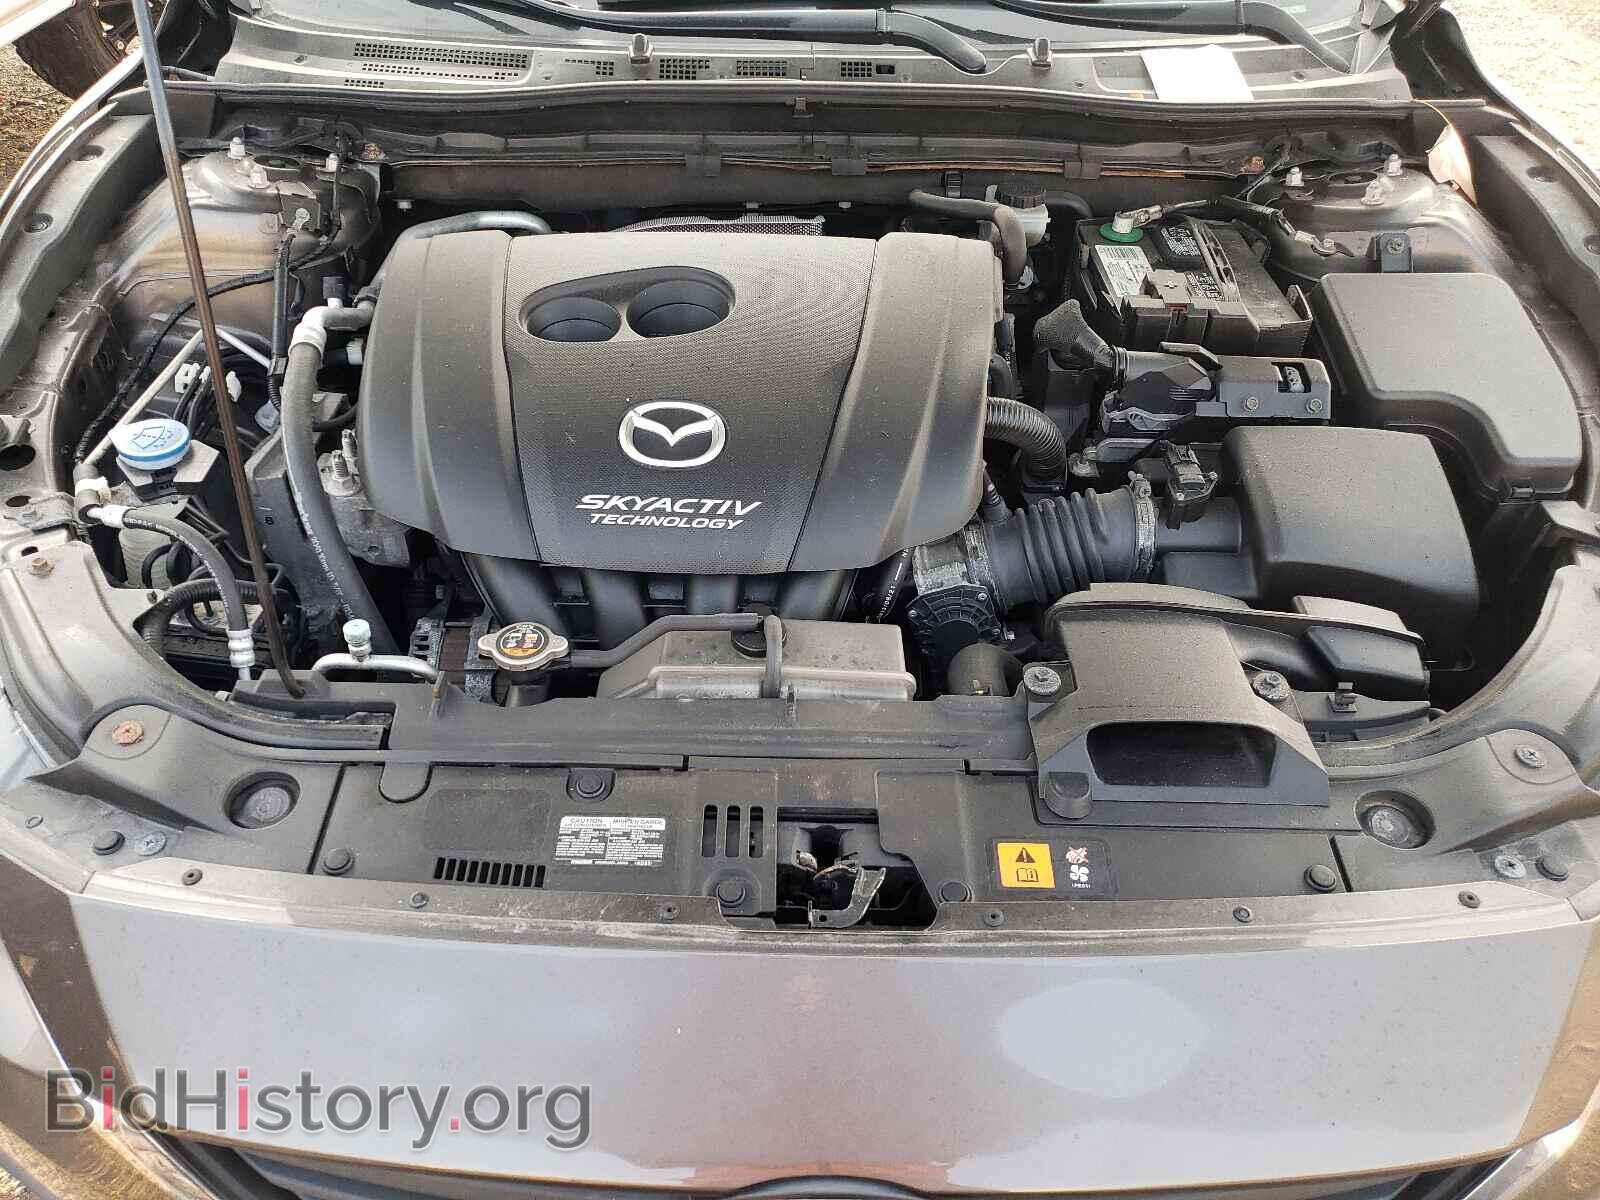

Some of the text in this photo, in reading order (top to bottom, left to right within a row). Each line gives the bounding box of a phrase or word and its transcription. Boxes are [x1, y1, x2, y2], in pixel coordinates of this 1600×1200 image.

[575, 494, 763, 516] SKYACTIV
[590, 513, 744, 530] TECHNOLOGY
[569, 817, 603, 825] CAUTION
